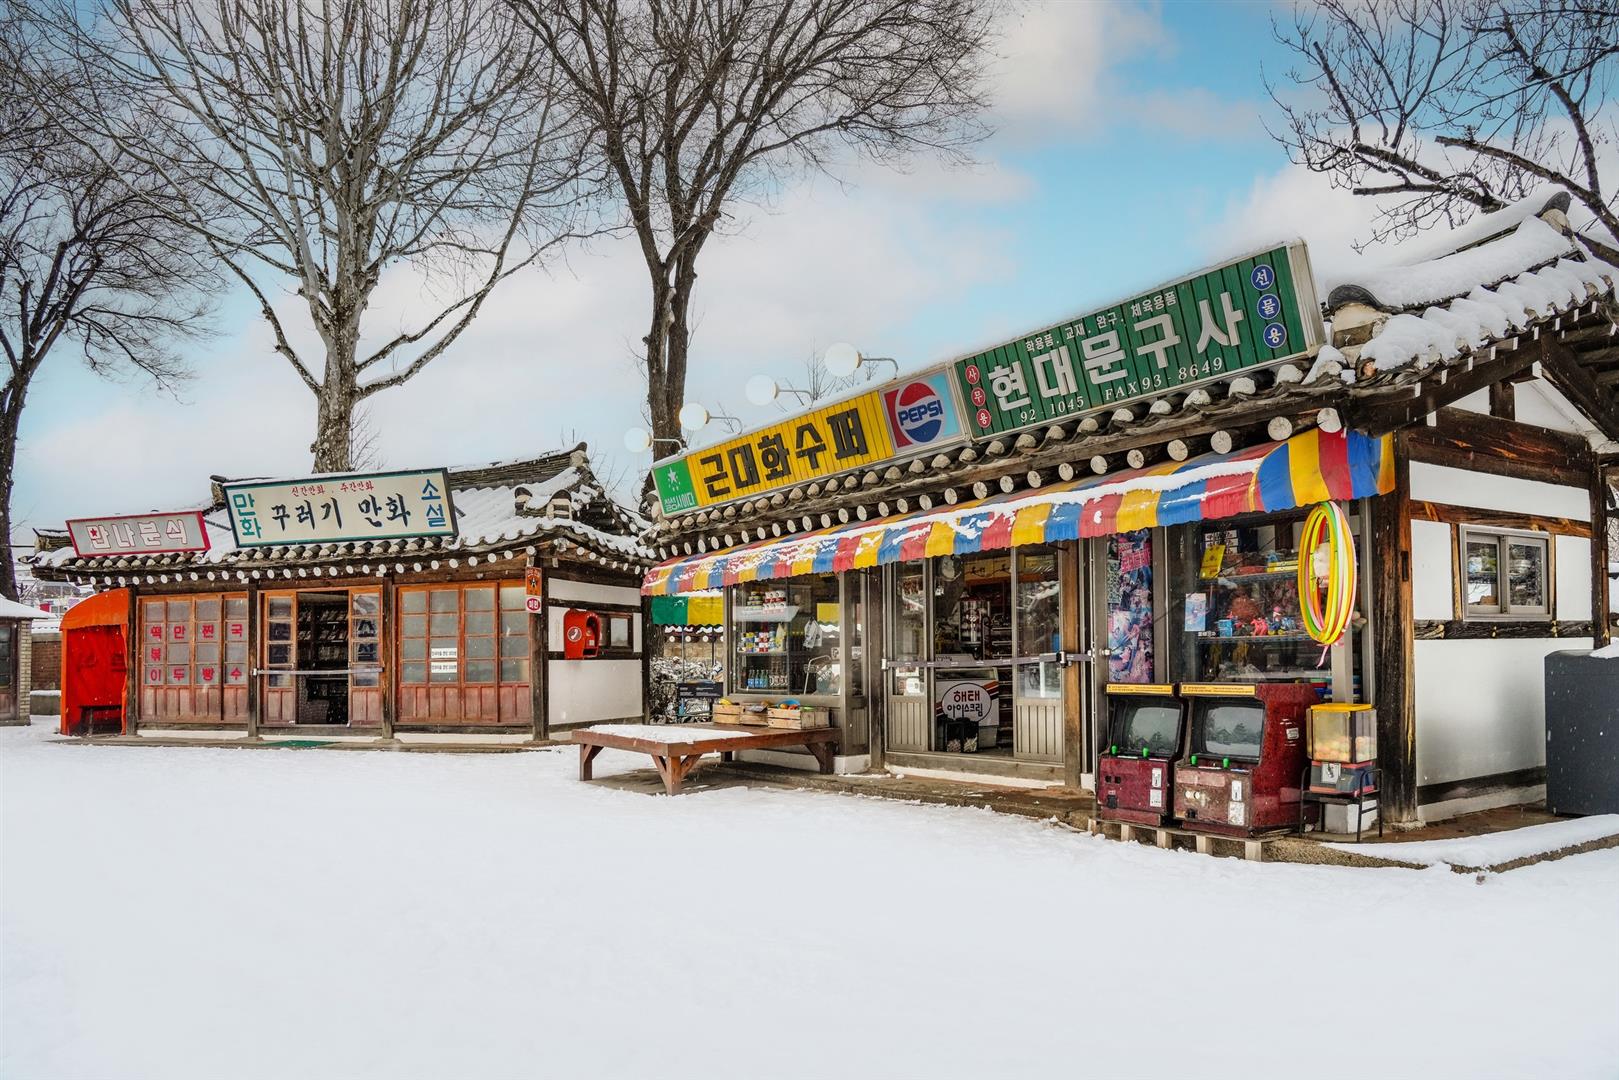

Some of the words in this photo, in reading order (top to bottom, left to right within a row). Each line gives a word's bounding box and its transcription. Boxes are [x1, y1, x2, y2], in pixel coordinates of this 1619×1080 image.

[1131, 291, 1177, 317] 체육용품
[1256, 269, 1282, 343] 선물용
[988, 291, 1244, 412] 현대문구사
[898, 400, 944, 426] PEPSI
[968, 368, 988, 425] 사무용
[700, 407, 870, 498] 근대화수퍼
[271, 497, 343, 531] 꾸러기
[358, 493, 411, 528] 만화
[292, 485, 325, 497] 신간만화
[340, 480, 374, 492] 주간만화
[421, 479, 446, 528] 소설
[86, 519, 188, 550] 만나분식
[233, 493, 261, 539] 만화
[173, 625, 186, 680] 만두
[230, 624, 243, 680] 국수
[953, 690, 980, 703] 해태
